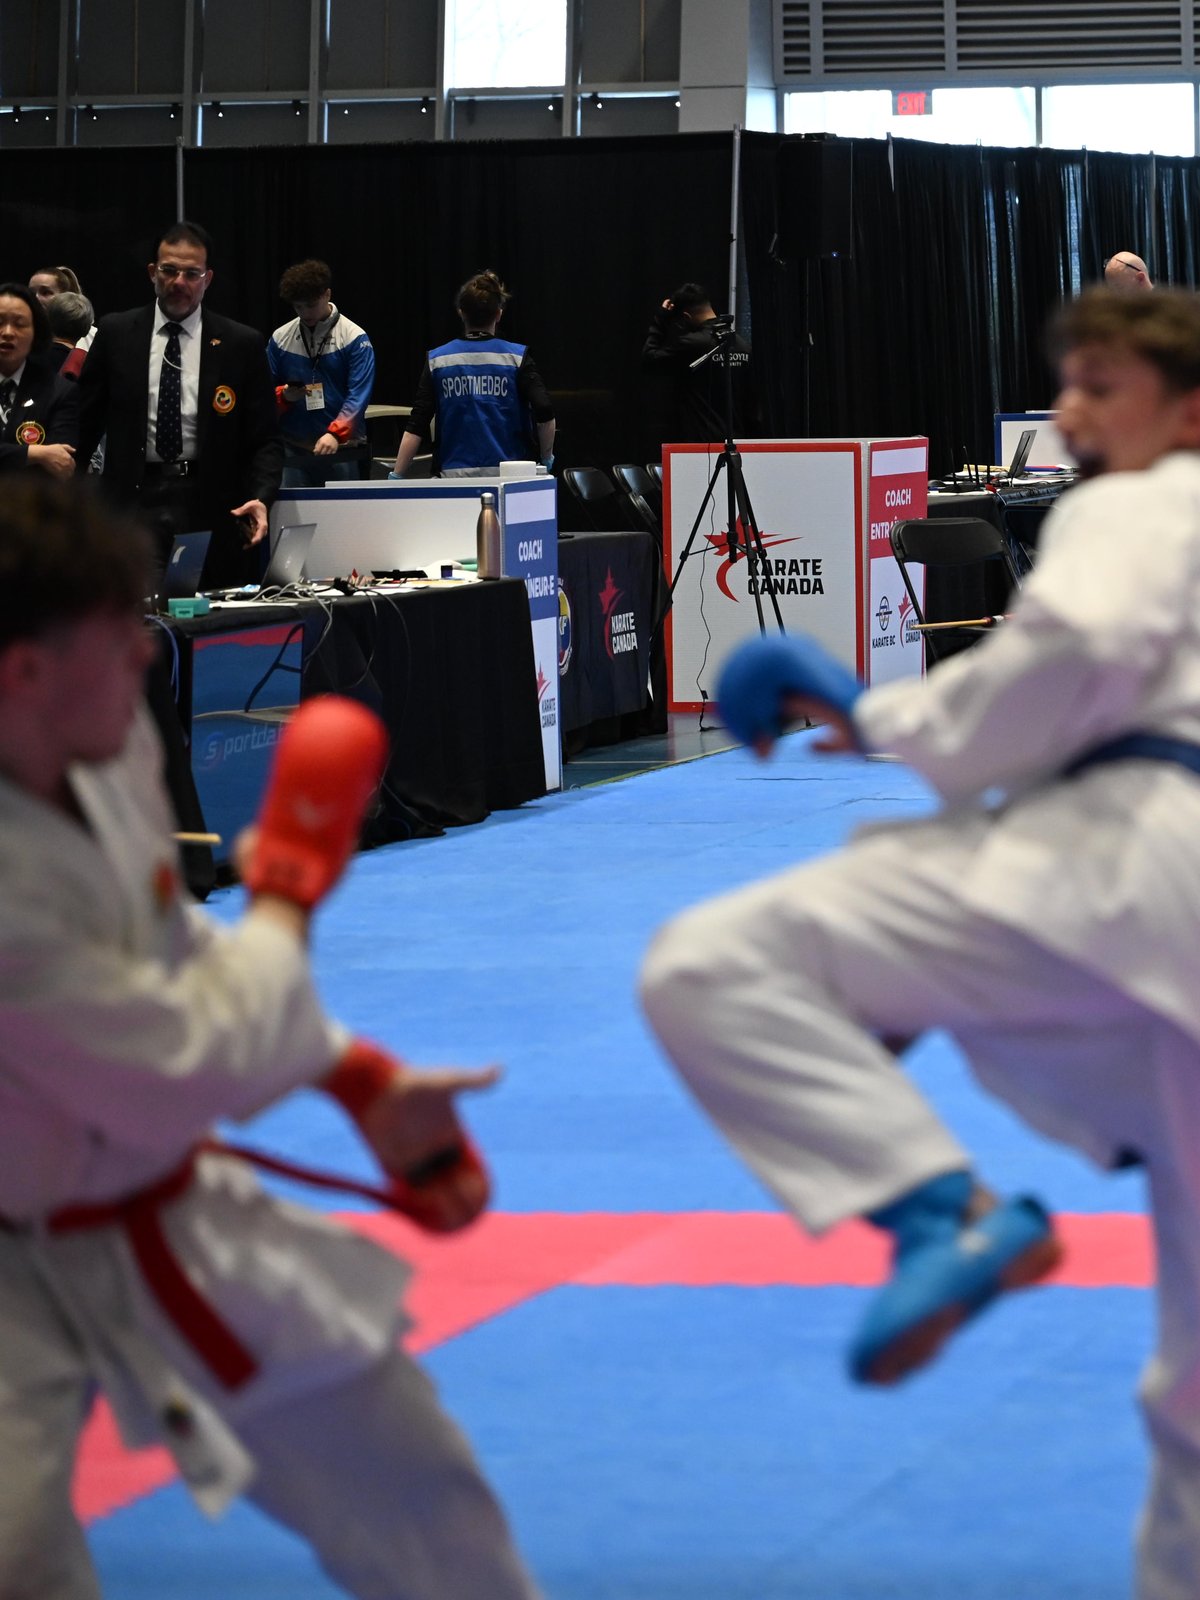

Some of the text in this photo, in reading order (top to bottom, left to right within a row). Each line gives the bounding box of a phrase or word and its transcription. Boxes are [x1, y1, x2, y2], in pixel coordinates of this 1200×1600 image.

[897, 91, 926, 115] EXIT
[442, 375, 508, 399] SPORTMEDBC
[885, 488, 912, 507] COACH
[518, 540, 543, 562] COACH
[748, 559, 823, 576] KARATE
[748, 578, 824, 595] CANADA
[611, 612, 636, 635] KARATE
[612, 632, 638, 654] CANADA
[872, 635, 896, 649] KARATE BC
